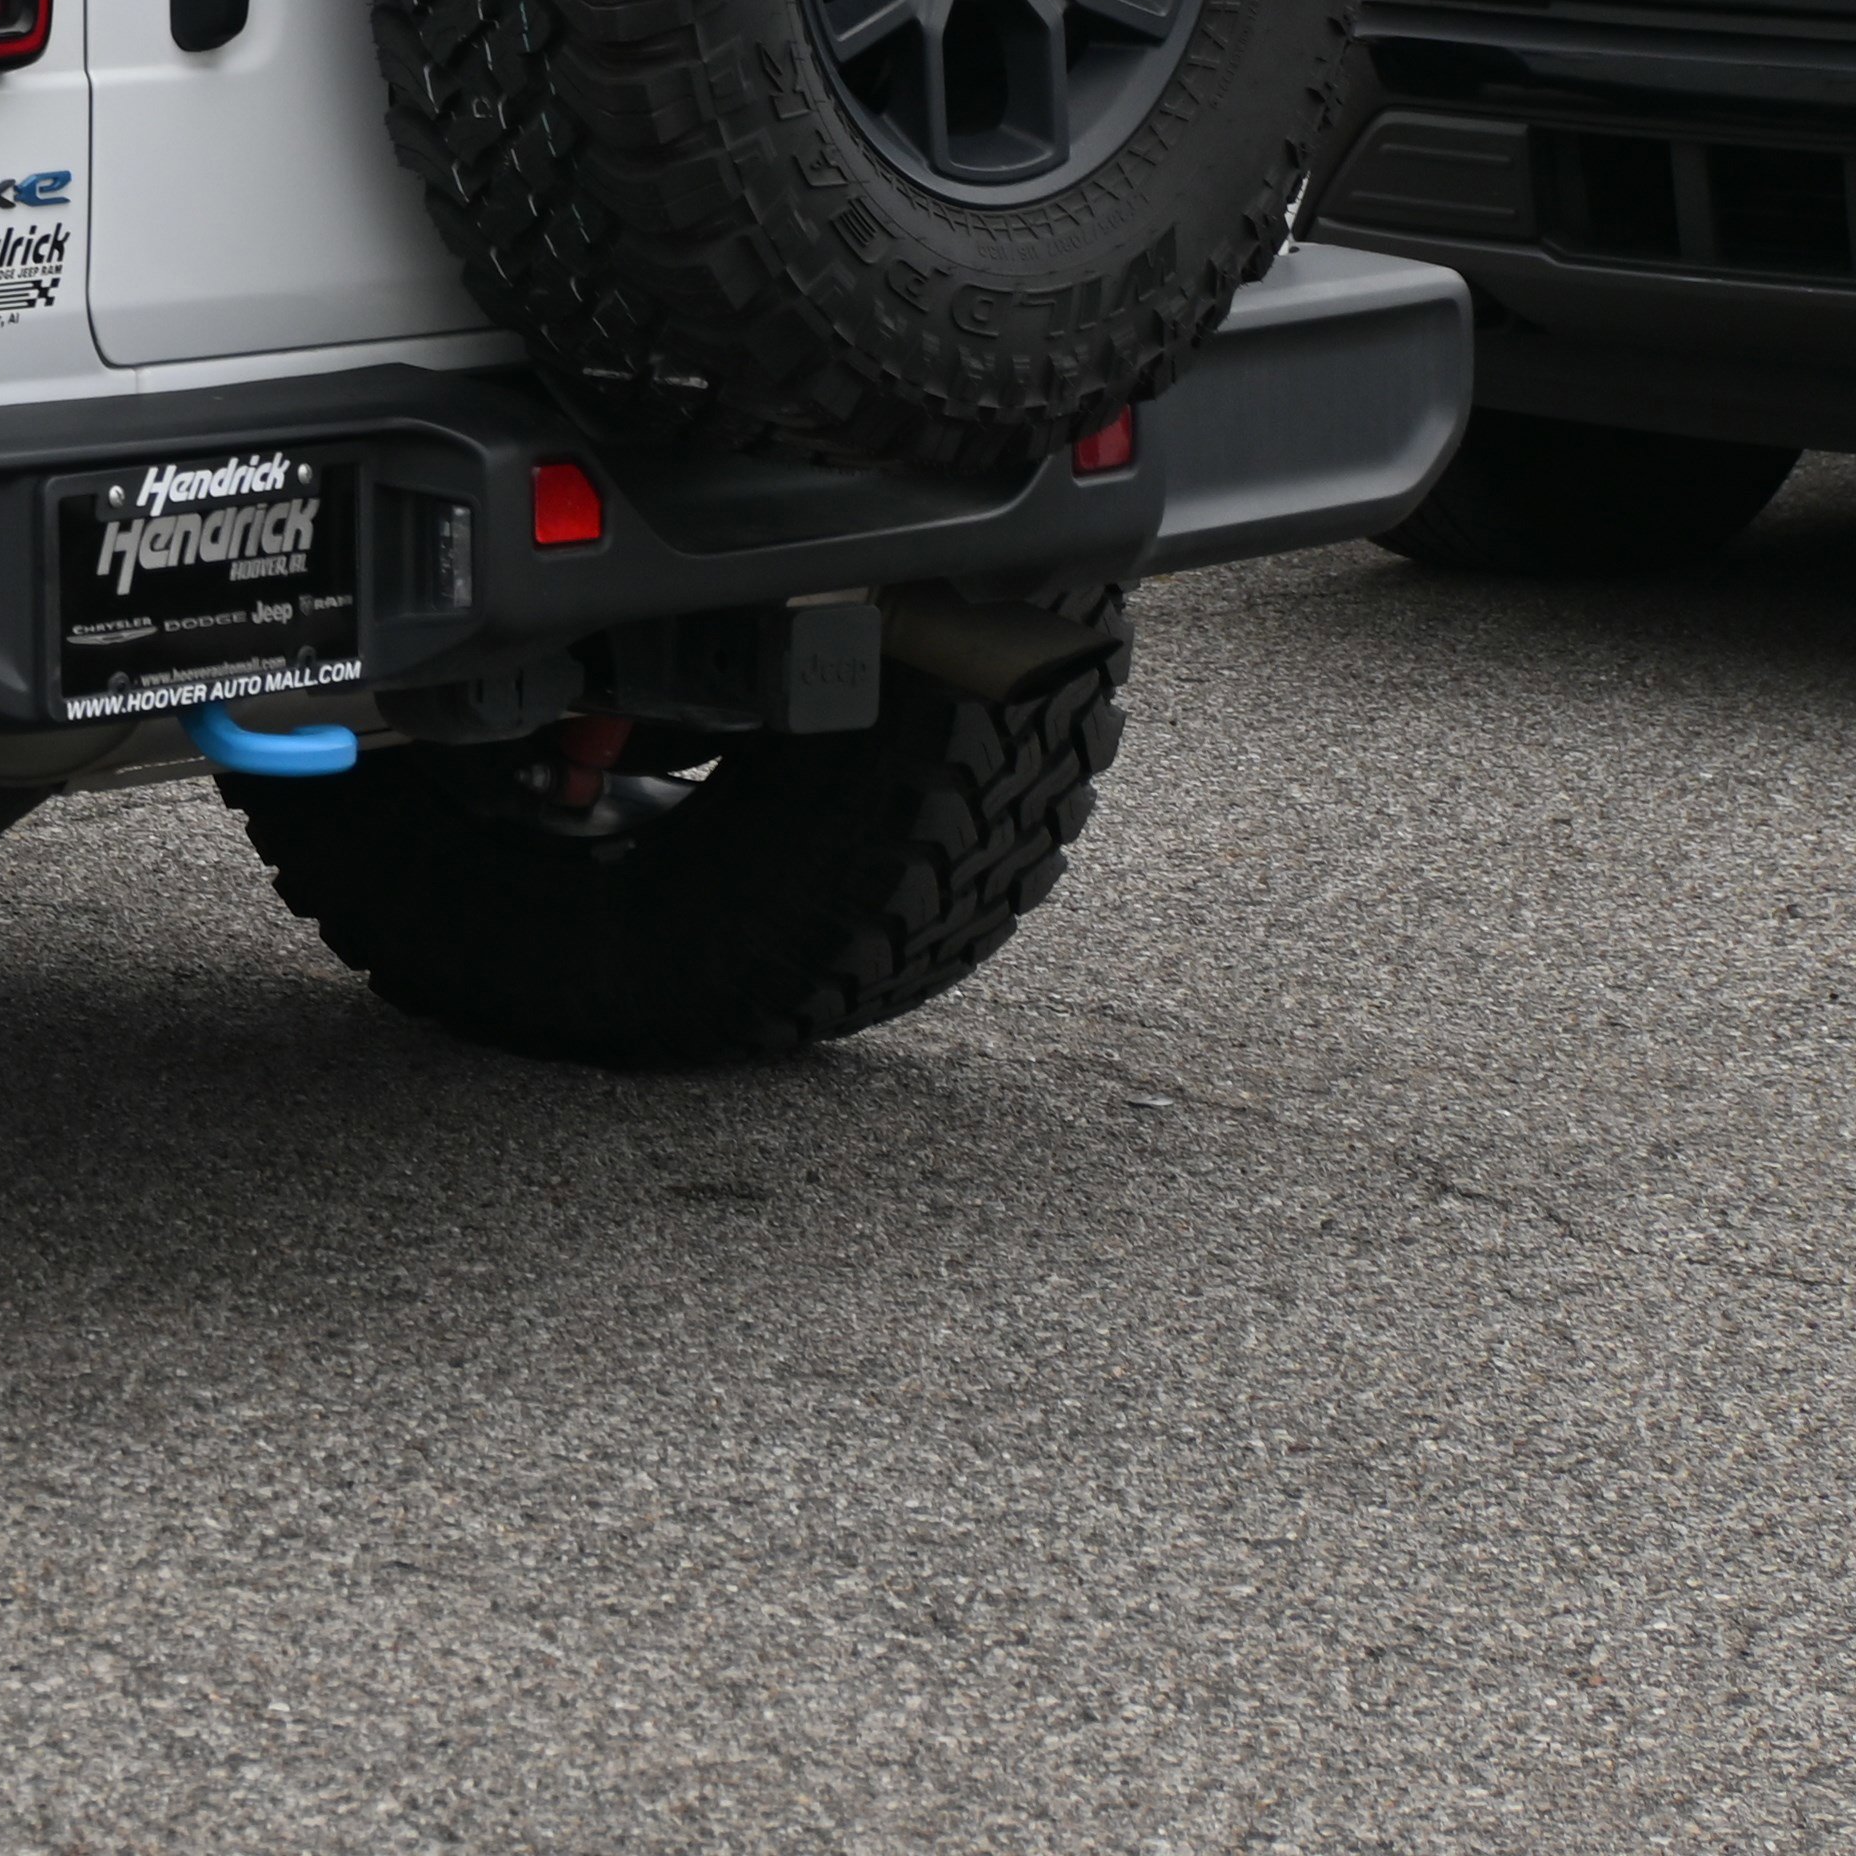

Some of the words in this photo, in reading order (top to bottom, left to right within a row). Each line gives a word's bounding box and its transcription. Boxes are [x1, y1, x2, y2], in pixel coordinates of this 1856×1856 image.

[17, 266, 40, 278] JEEP
[40, 264, 63, 276] RAM
[136, 452, 291, 517] Hendrick
[96, 497, 320, 596] Hendrick
[72, 616, 153, 635] CHRYSLER
[163, 610, 247, 632] DODGE
[251, 600, 294, 625] Jeep
[314, 594, 354, 610] RAM
[66, 683, 206, 721] WWW.HOOVER
[210, 676, 262, 702] AUTO
[264, 660, 362, 693] MALL.COM
[140, 655, 286, 687] www.hooverautomall.com
[800, 653, 866, 687] Jeep
